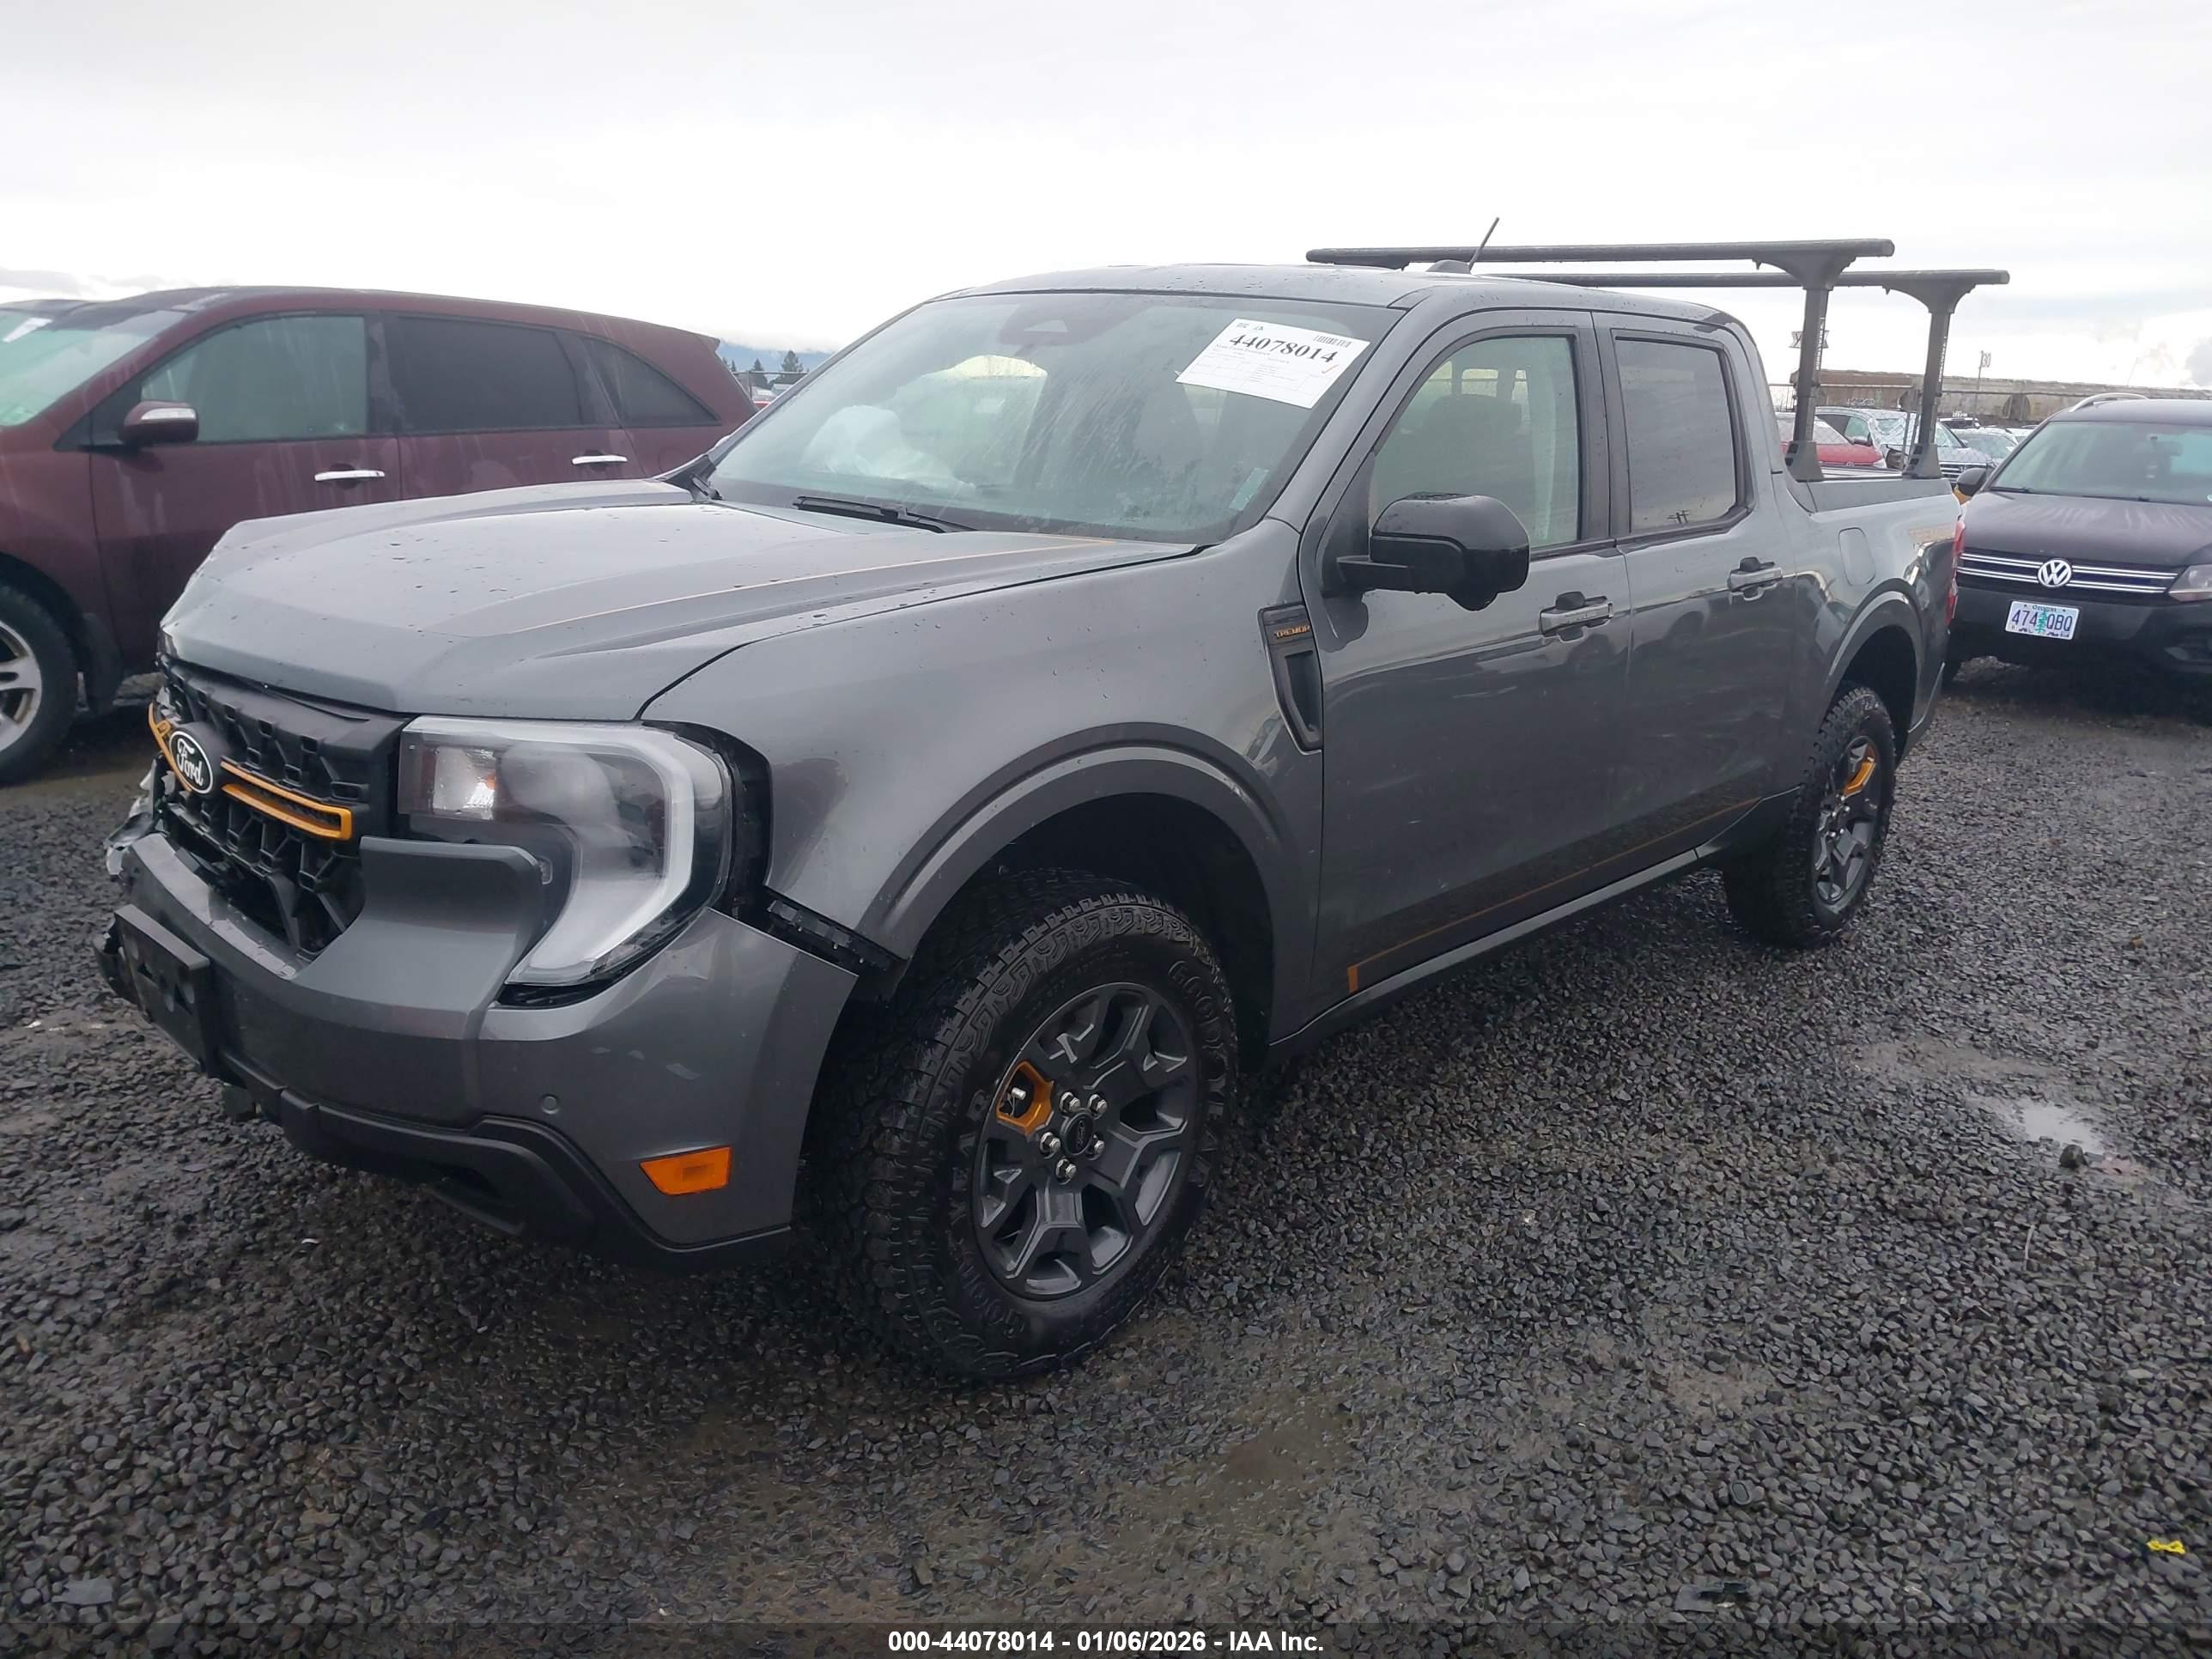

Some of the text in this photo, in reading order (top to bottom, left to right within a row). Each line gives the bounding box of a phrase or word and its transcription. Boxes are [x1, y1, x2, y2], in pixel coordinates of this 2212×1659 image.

[1229, 334, 1339, 363] 44078014
[2011, 609, 2039, 628] 474
[177, 738, 204, 786] Ford
